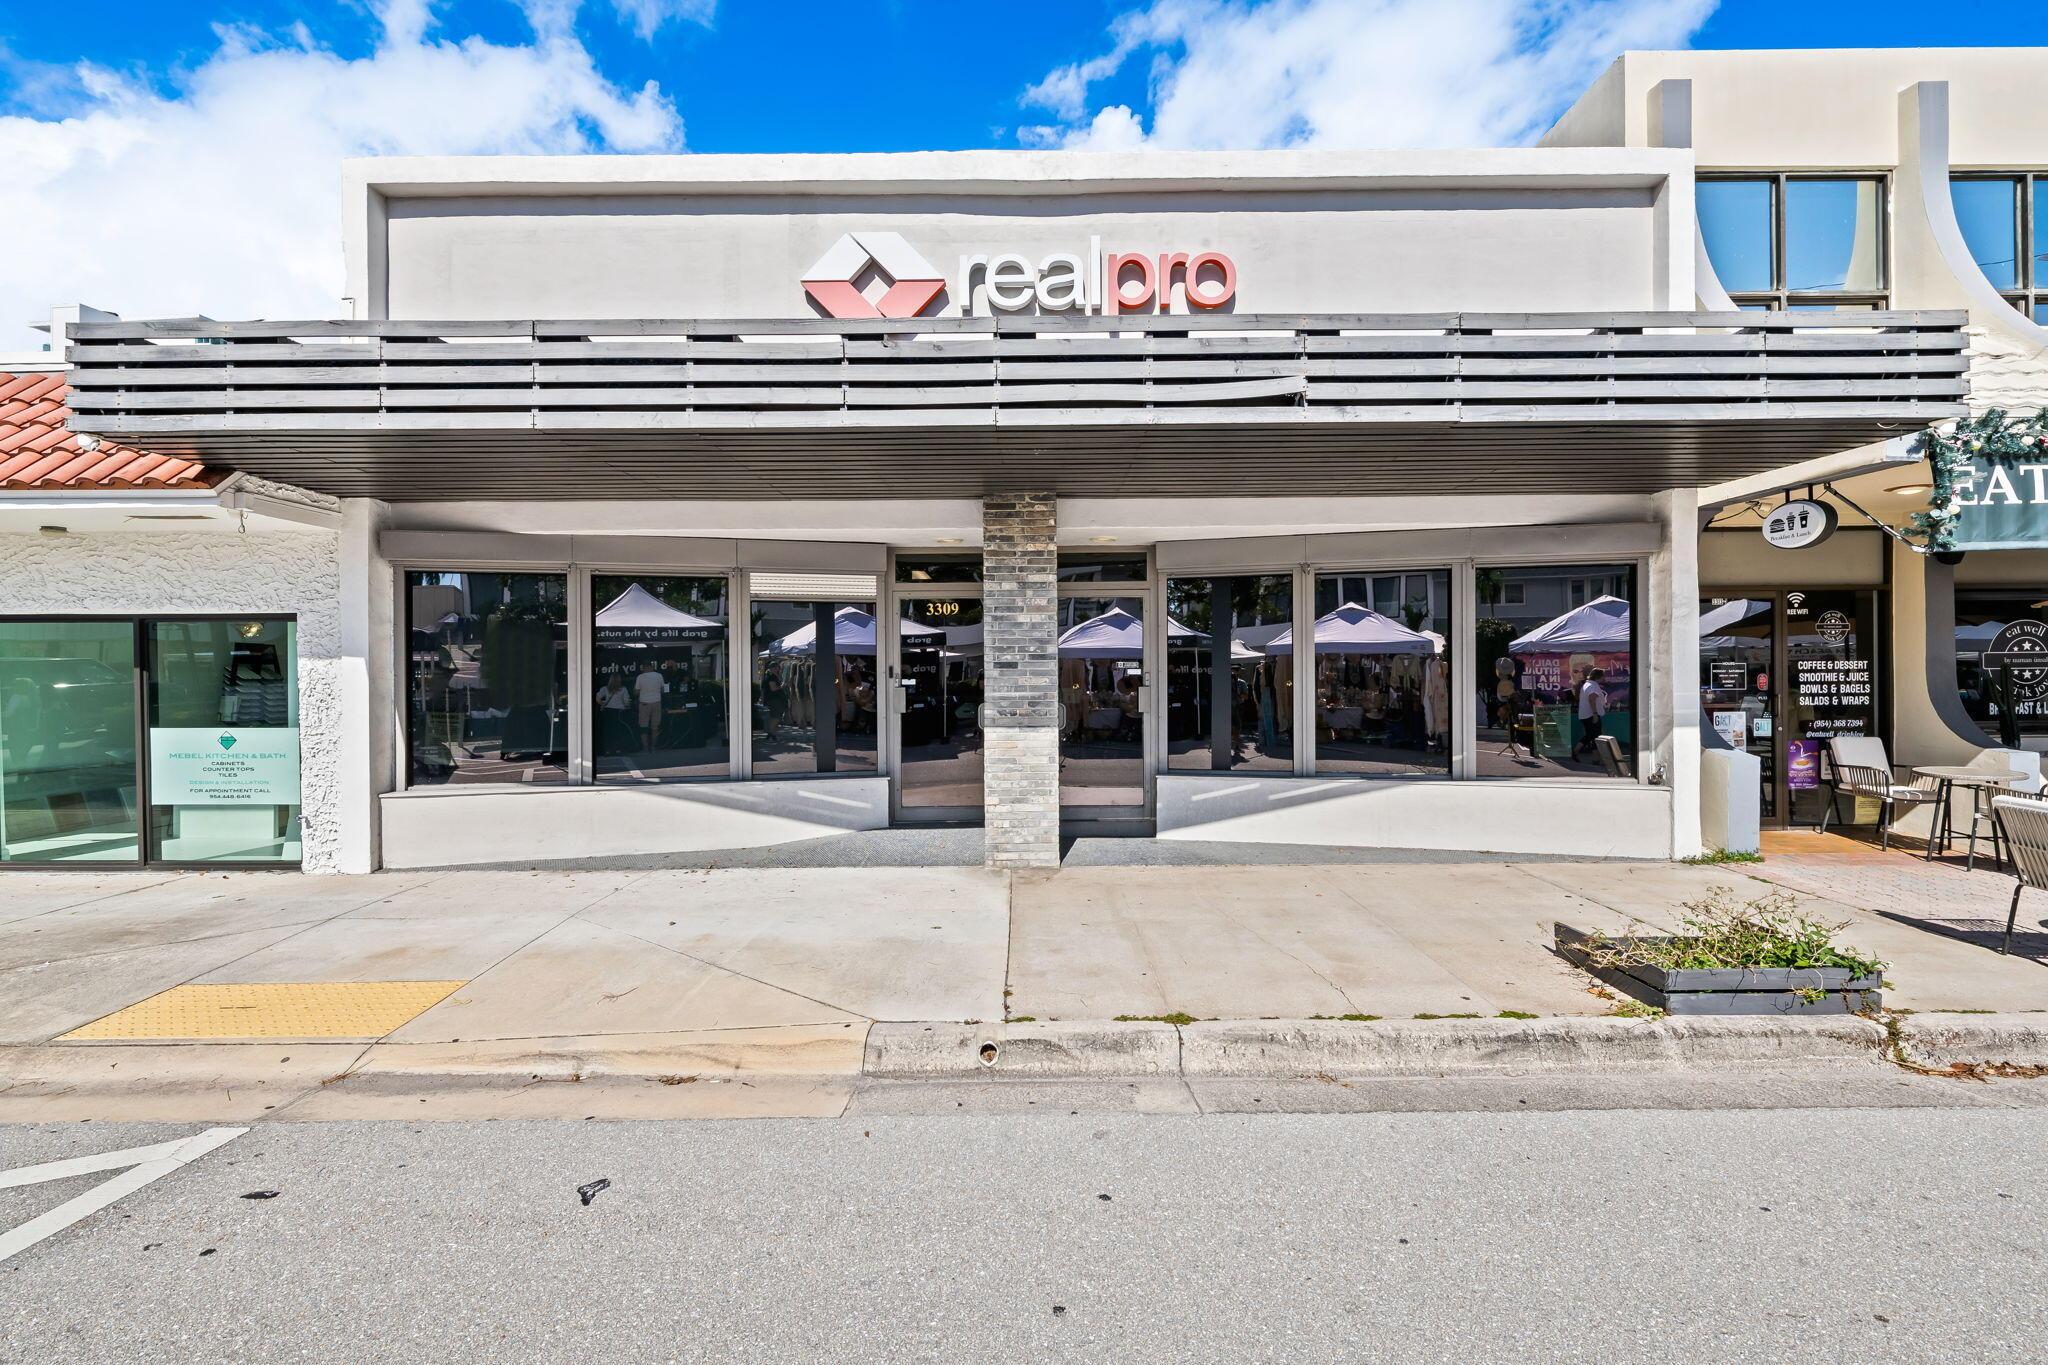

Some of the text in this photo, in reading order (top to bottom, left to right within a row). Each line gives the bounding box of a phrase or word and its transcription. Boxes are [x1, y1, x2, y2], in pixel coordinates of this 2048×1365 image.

[958, 235, 1238, 316] realpro
[1952, 465, 2048, 506] EAT
[926, 602, 959, 616] 3309
[2006, 625, 2046, 638] eat well
[1798, 660, 1868, 670] COFFEE & DESSERT
[1798, 672, 1869, 682] SMOOTHIE & JUICE
[1800, 684, 1870, 693] BOWLS & BAGELS
[1799, 696, 1869, 705] SALADS & WRAPS
[2035, 702, 2042, 714] &
[1813, 720, 1832, 729] (954)
